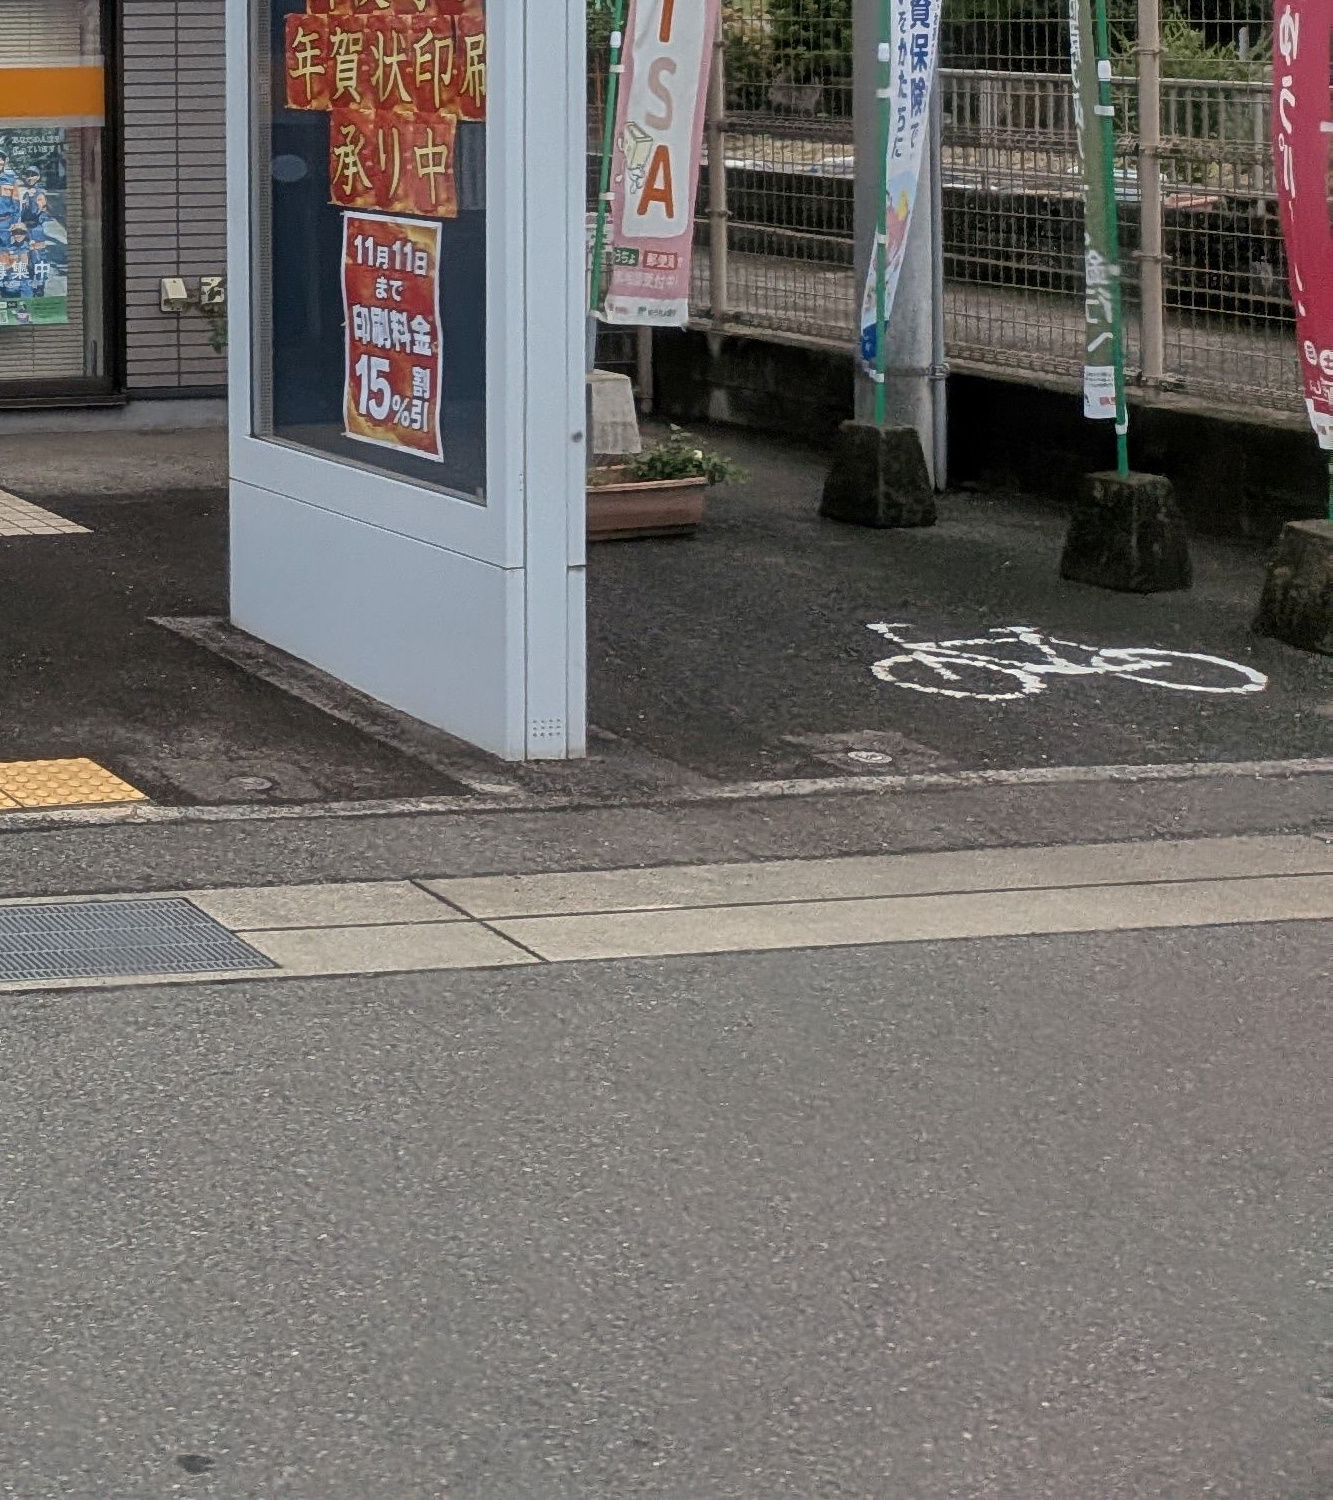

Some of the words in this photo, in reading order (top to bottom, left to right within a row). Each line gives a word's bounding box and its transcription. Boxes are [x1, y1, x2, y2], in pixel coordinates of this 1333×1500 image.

[332, 123, 448, 205] 承り中
[353, 234, 428, 276] 11月11日
[374, 275, 404, 302] まで
[352, 304, 433, 357] 印刷料金
